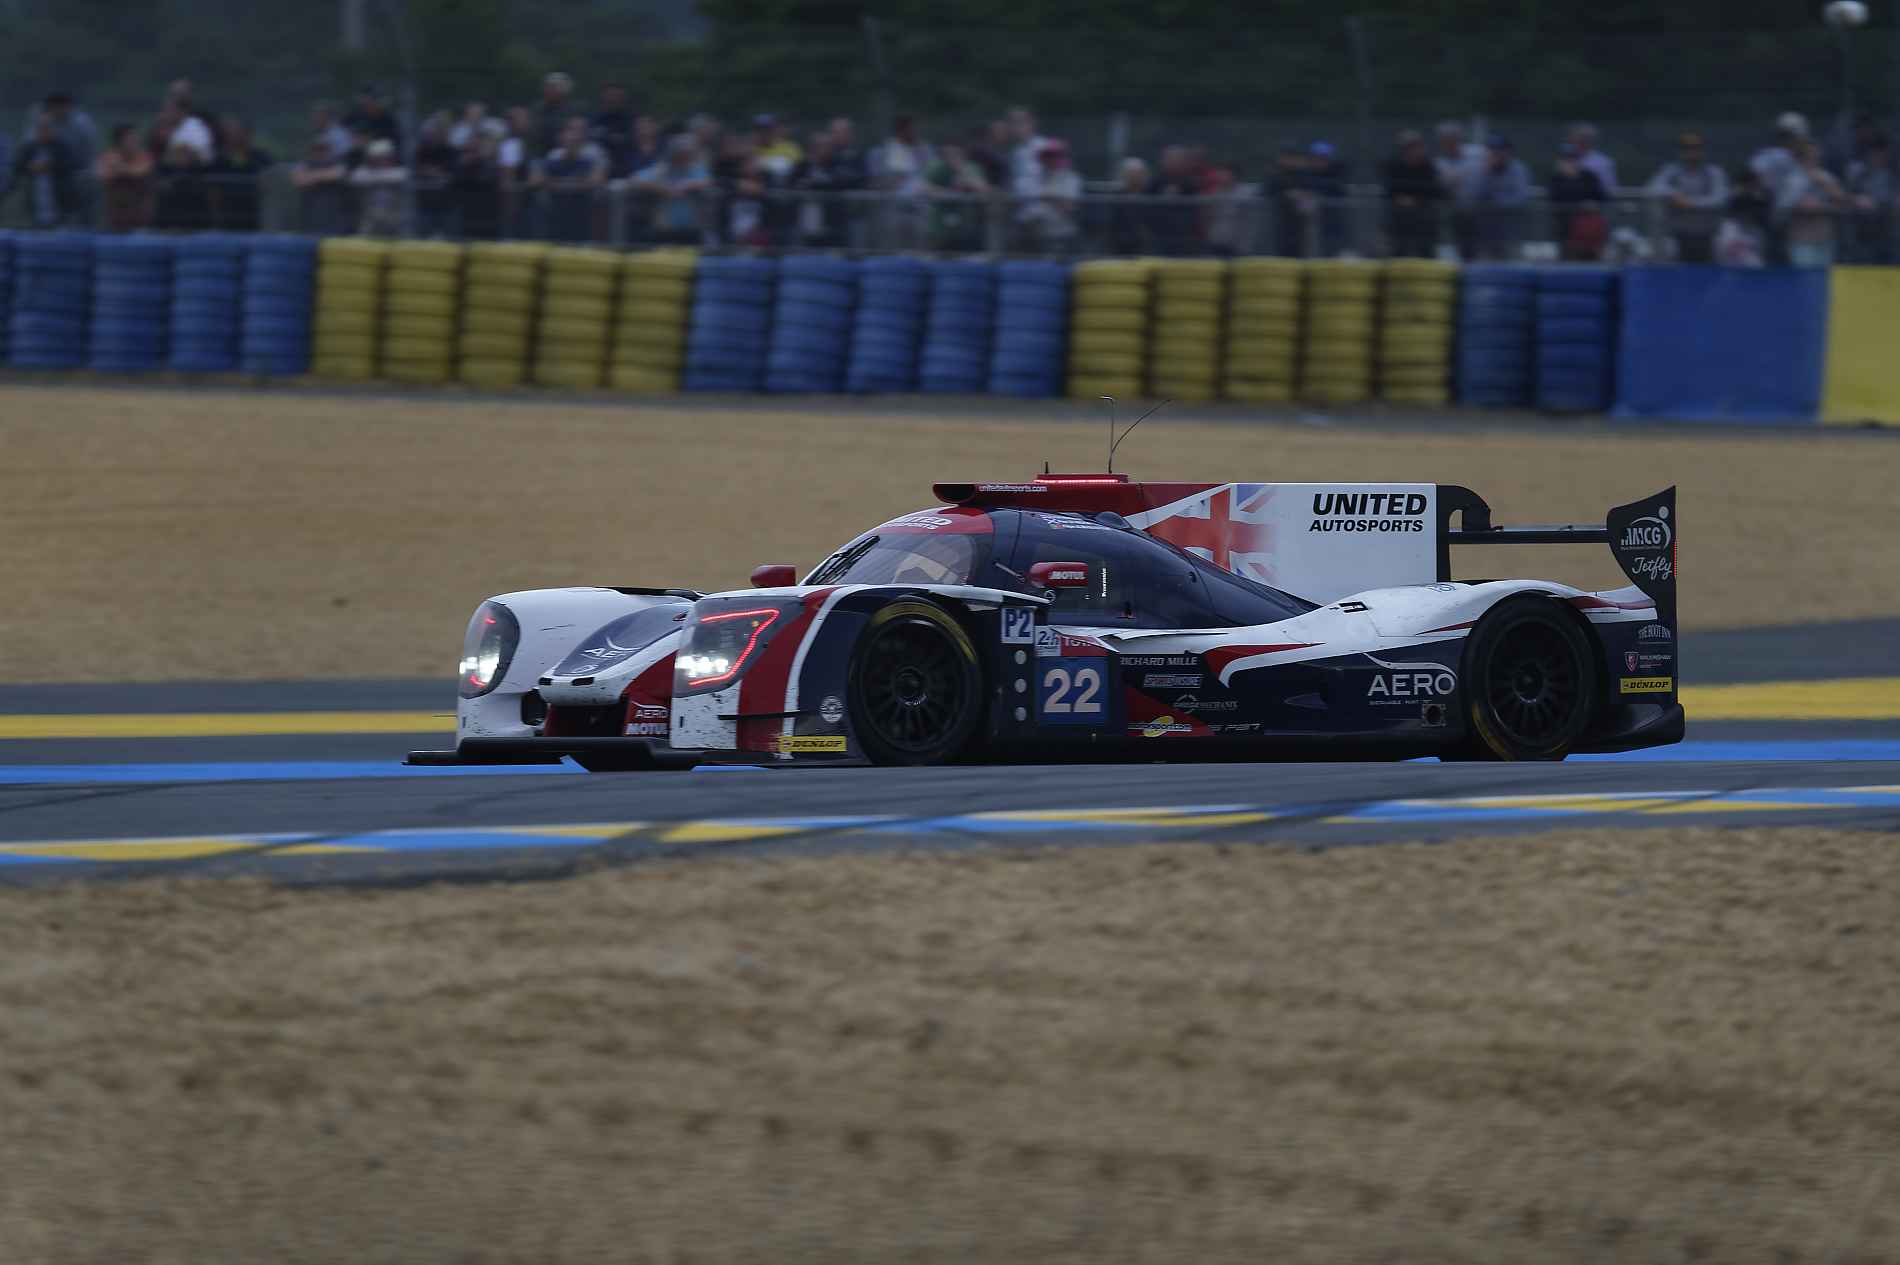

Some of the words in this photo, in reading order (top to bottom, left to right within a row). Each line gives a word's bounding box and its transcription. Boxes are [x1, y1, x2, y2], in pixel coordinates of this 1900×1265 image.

[1313, 493, 1427, 516] UNITED
[1309, 519, 1424, 532] AUTOSPORTS
[1049, 570, 1087, 580] MOTUL
[1006, 608, 1031, 638] P2
[1119, 656, 1165, 666] RICHARD
[1167, 656, 1198, 666] MILLE
[1043, 668, 1103, 713] 22
[1367, 673, 1456, 696] AERO
[1630, 681, 1669, 689] DUNLOP
[791, 740, 842, 748] DUNLOP
